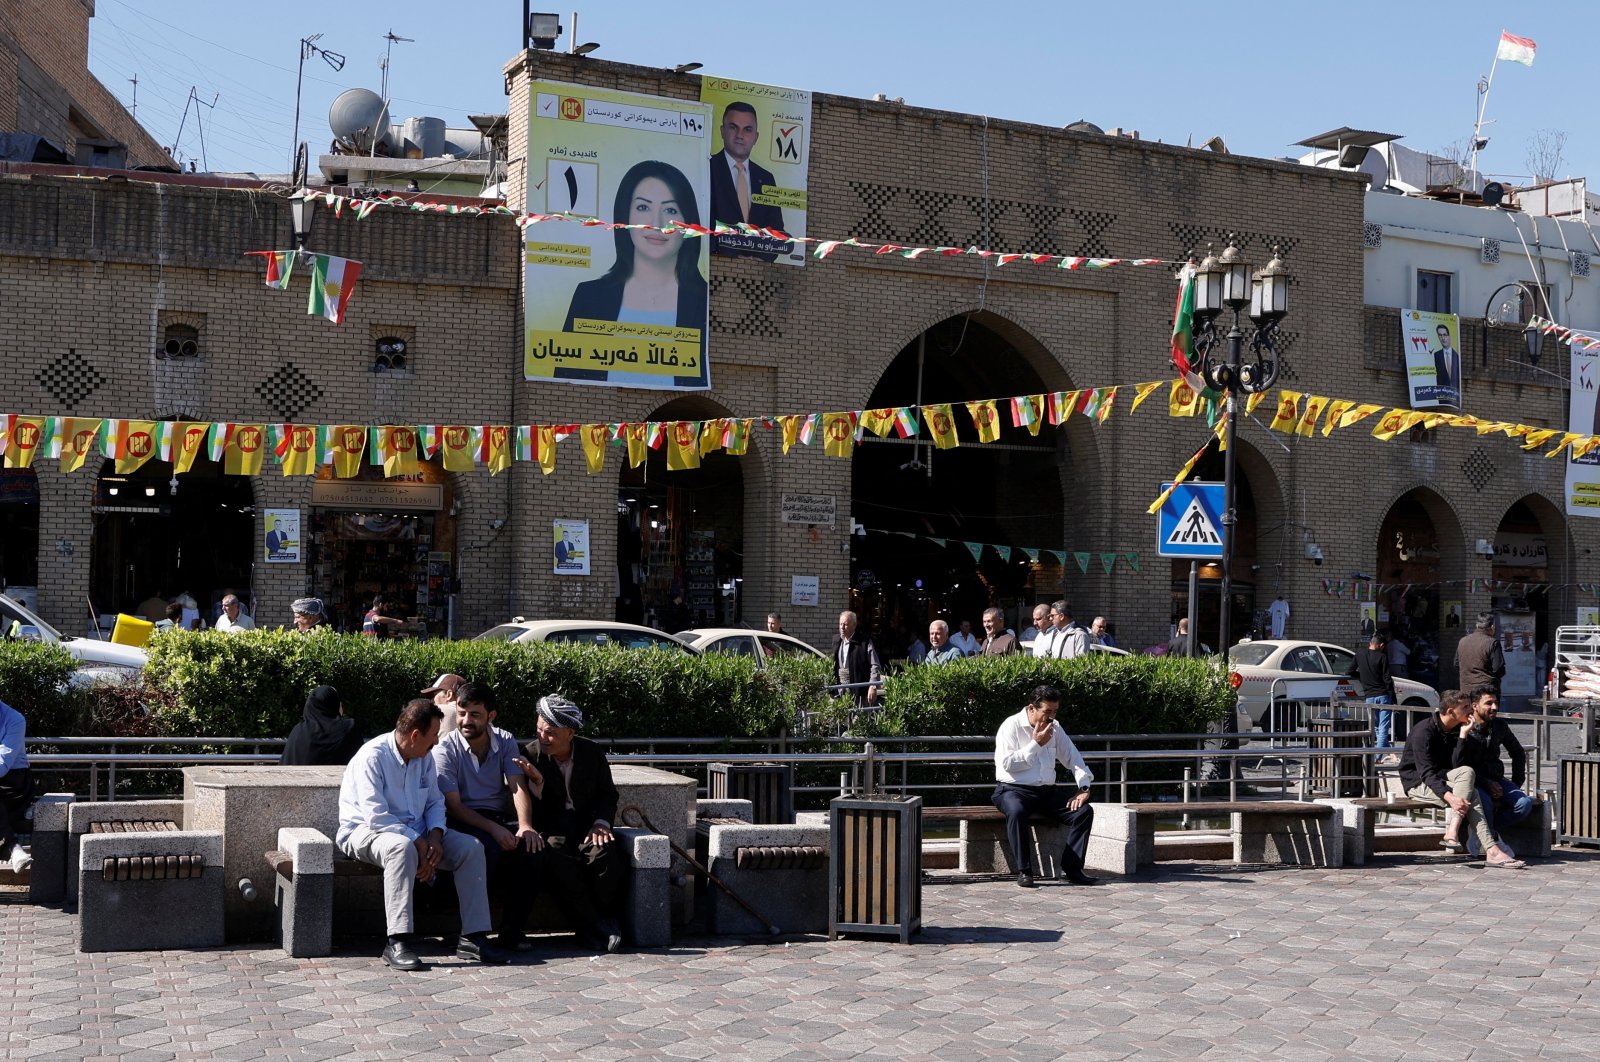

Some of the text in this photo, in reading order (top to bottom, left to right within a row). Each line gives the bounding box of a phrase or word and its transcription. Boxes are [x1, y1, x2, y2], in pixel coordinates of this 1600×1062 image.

[796, 92, 807, 100] ١٩٠
[587, 107, 678, 129] پارتی دیموکراتی کوردستان
[682, 118, 703, 132] ١٩٠
[548, 145, 598, 158] کاندیدی ژمارە
[775, 136, 798, 160] ١٨
[564, 165, 578, 210] ١
[577, 321, 607, 331] کوردستان
[532, 338, 582, 363] سیان
[589, 346, 639, 366] فەرید
[1579, 375, 1594, 391] ١٨
